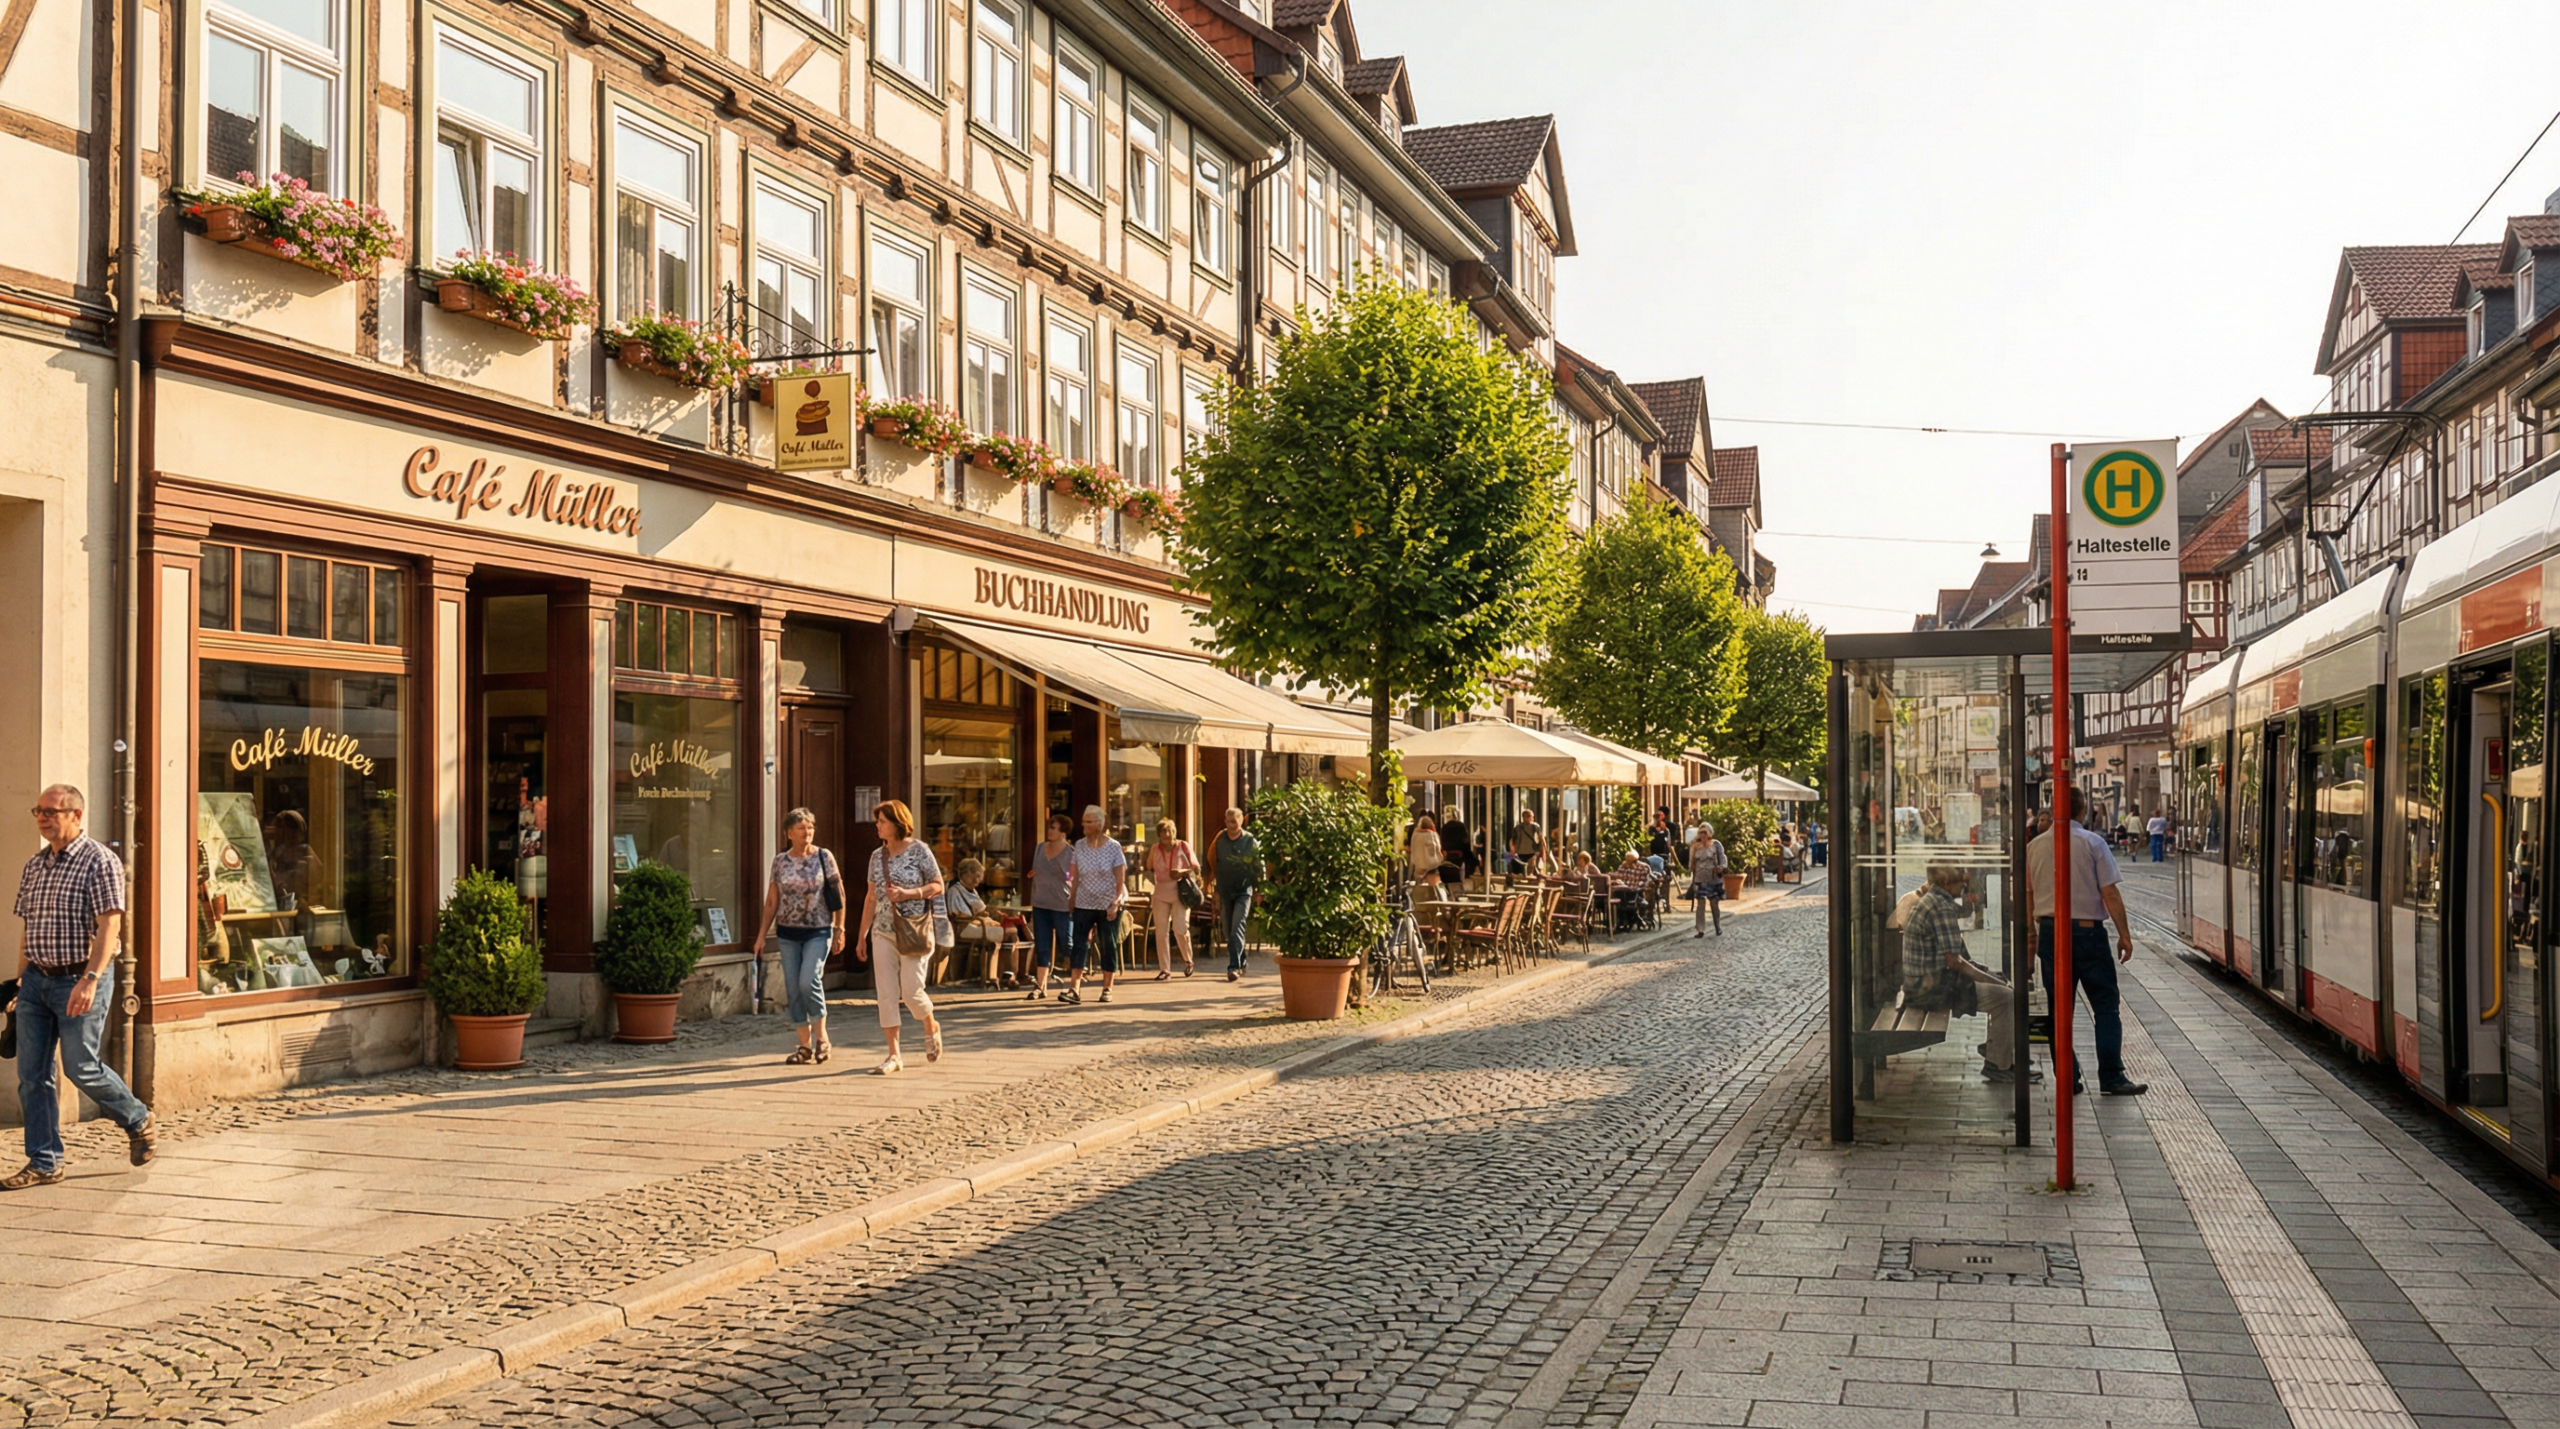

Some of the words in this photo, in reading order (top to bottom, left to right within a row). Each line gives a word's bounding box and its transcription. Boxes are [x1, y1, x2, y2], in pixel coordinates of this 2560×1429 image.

[402, 445, 506, 520] Café
[509, 468, 643, 538] Müller
[2106, 468, 2141, 509] H
[2077, 536, 2171, 554] Haltestelle
[974, 566, 1150, 634] BUCHHANDLUNG
[231, 727, 288, 771] Café
[292, 725, 375, 776] Müller
[630, 741, 665, 778] Café
